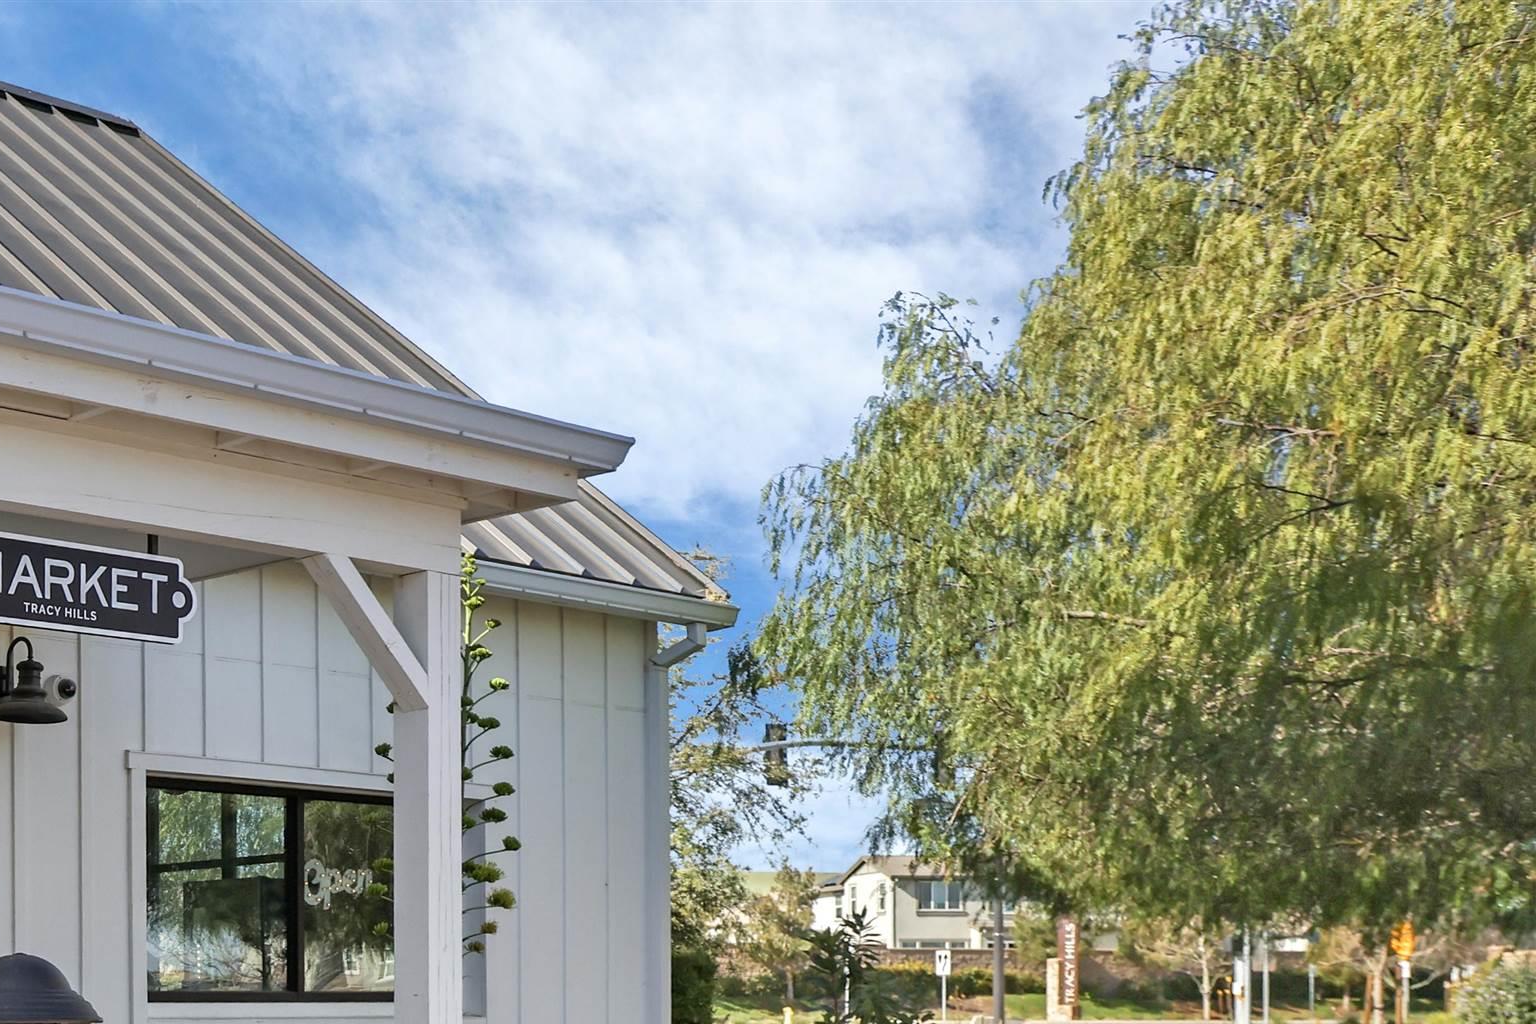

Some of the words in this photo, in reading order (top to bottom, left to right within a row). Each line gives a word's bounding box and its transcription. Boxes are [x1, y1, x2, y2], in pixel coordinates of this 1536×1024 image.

[24, 602, 60, 616] TRACY
[65, 607, 97, 621] HILLS
[304, 858, 373, 910] Open
[1065, 923, 1076, 959] HILLS
[1064, 962, 1075, 1003] TRACY
